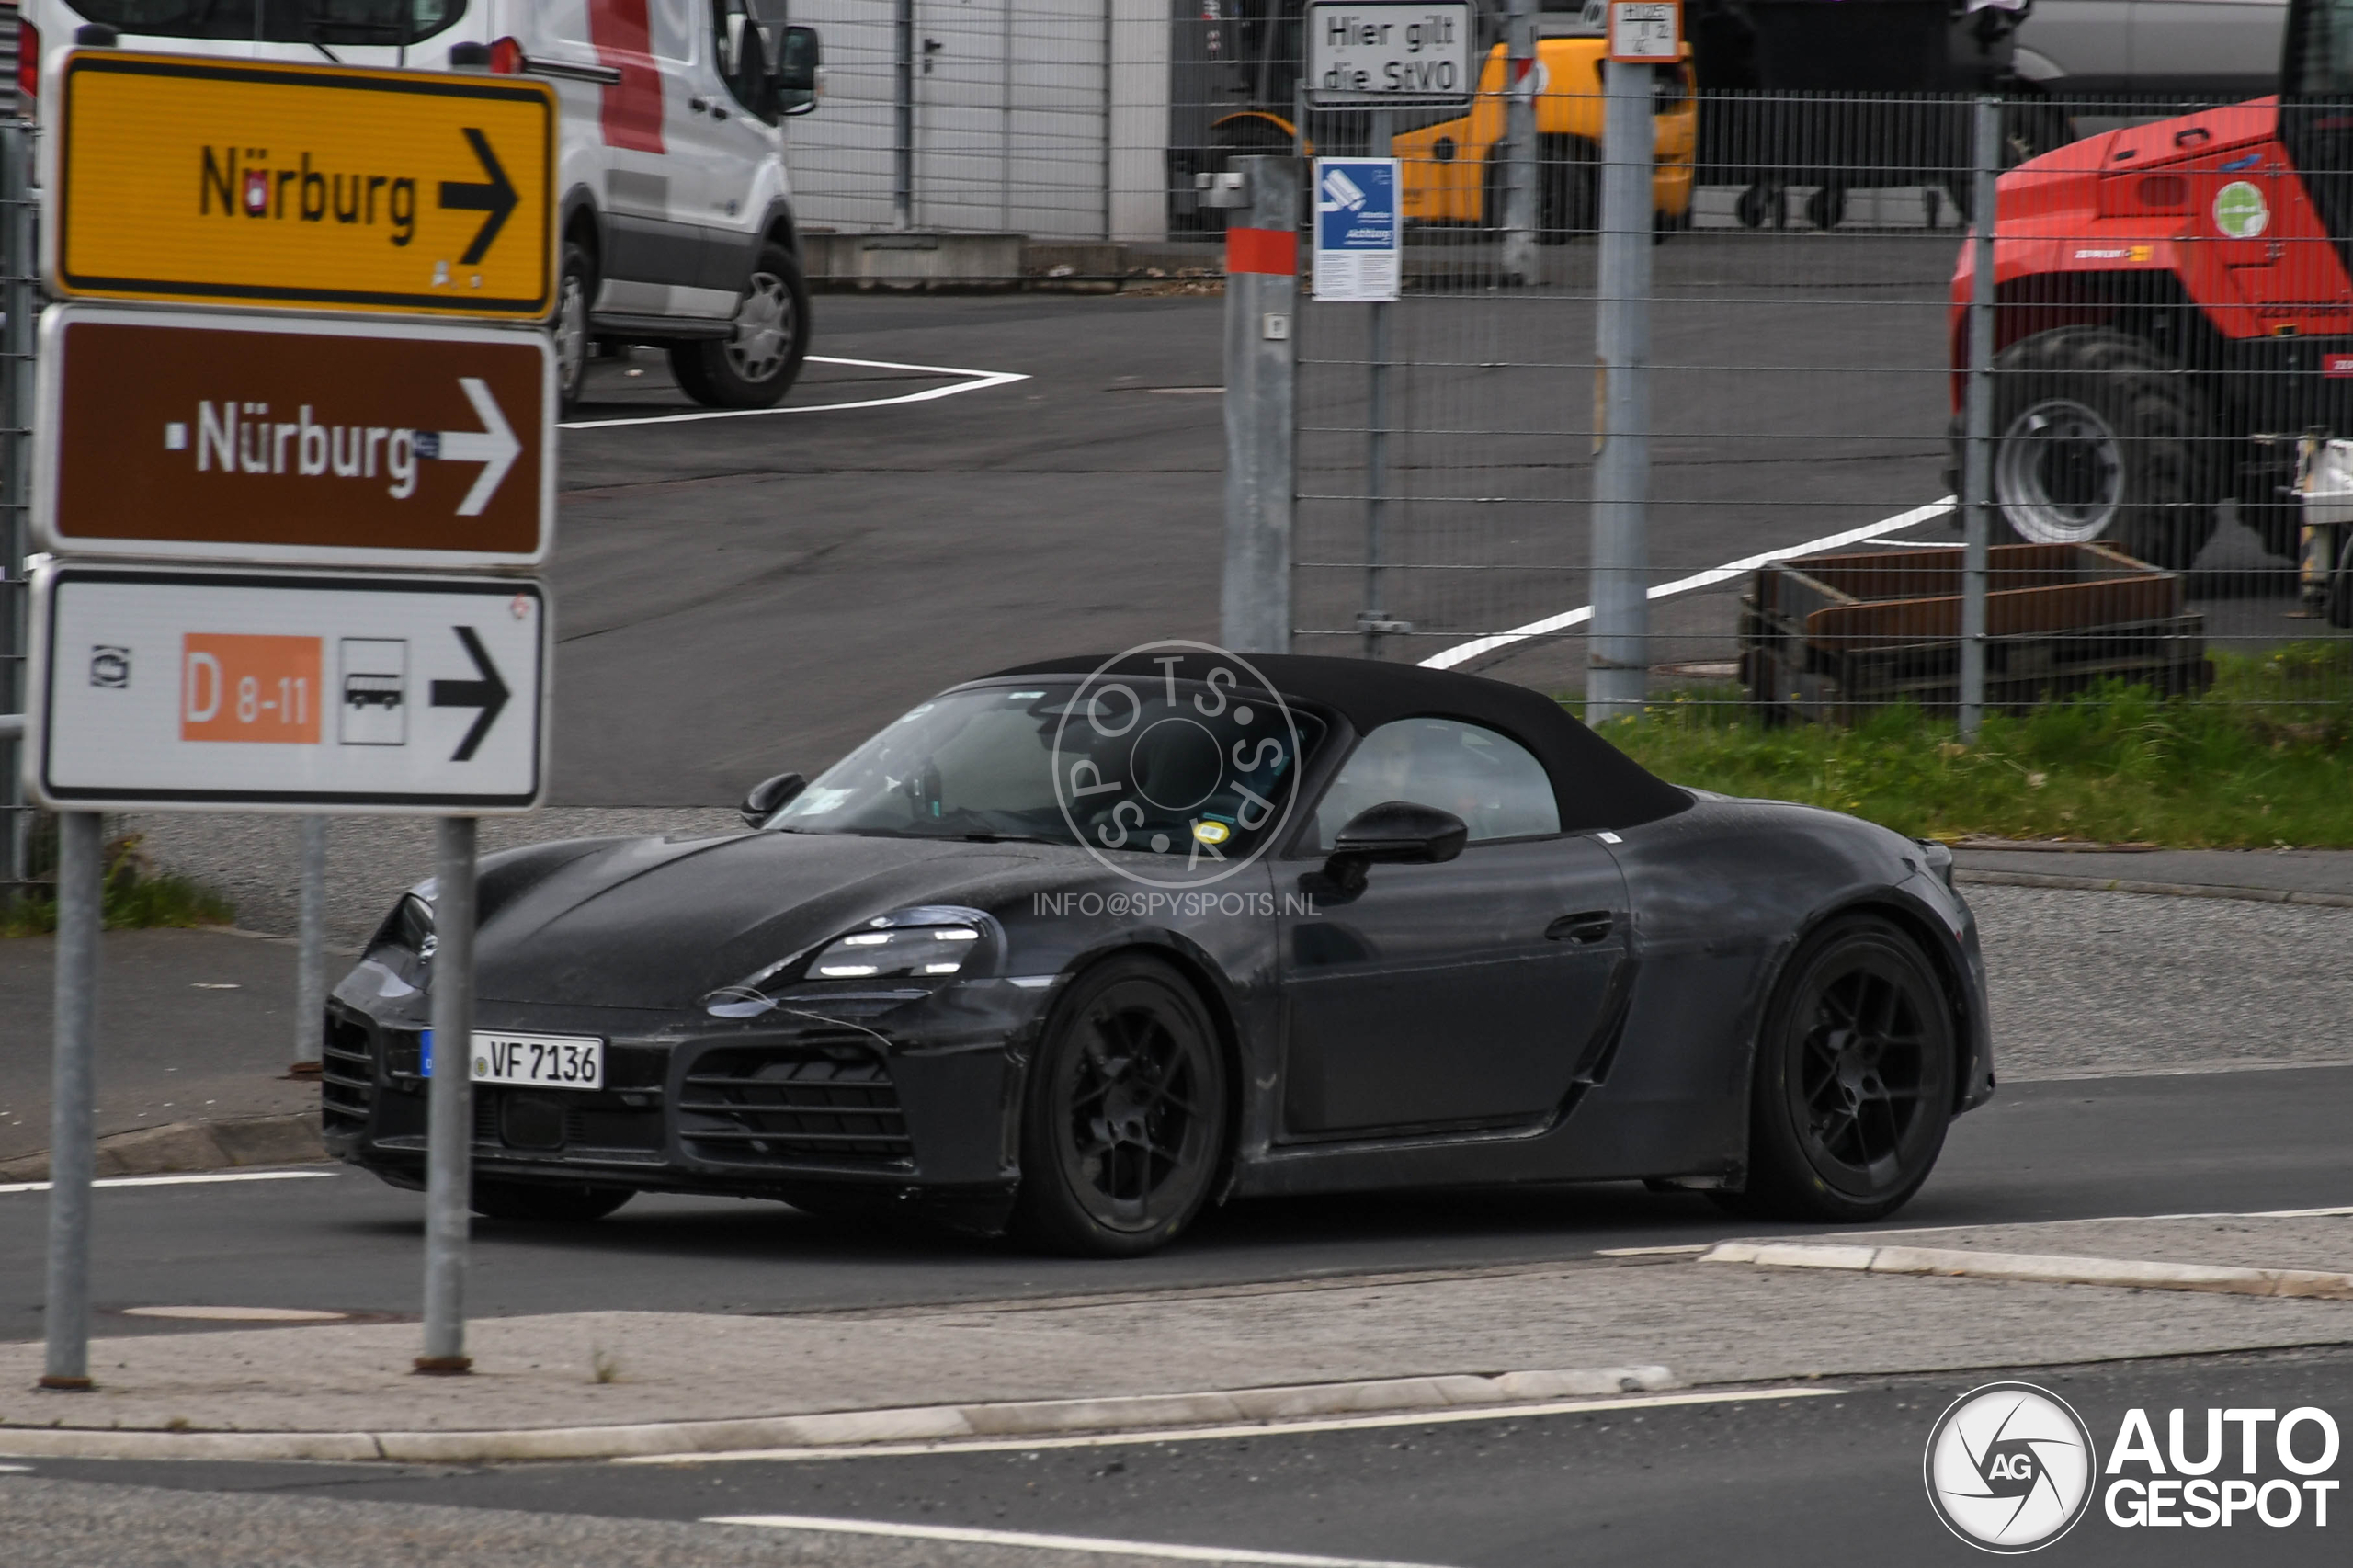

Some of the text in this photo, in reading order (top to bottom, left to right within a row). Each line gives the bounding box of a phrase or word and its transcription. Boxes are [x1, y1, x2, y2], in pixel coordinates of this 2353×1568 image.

[1327, 15, 1455, 52] Hier gilt
[1324, 61, 1458, 90] die StVO
[199, 145, 417, 247] Nürburg
[197, 400, 418, 499] Nürburg
[186, 652, 309, 724] D 8-11
[491, 1041, 597, 1082] VF 7136
